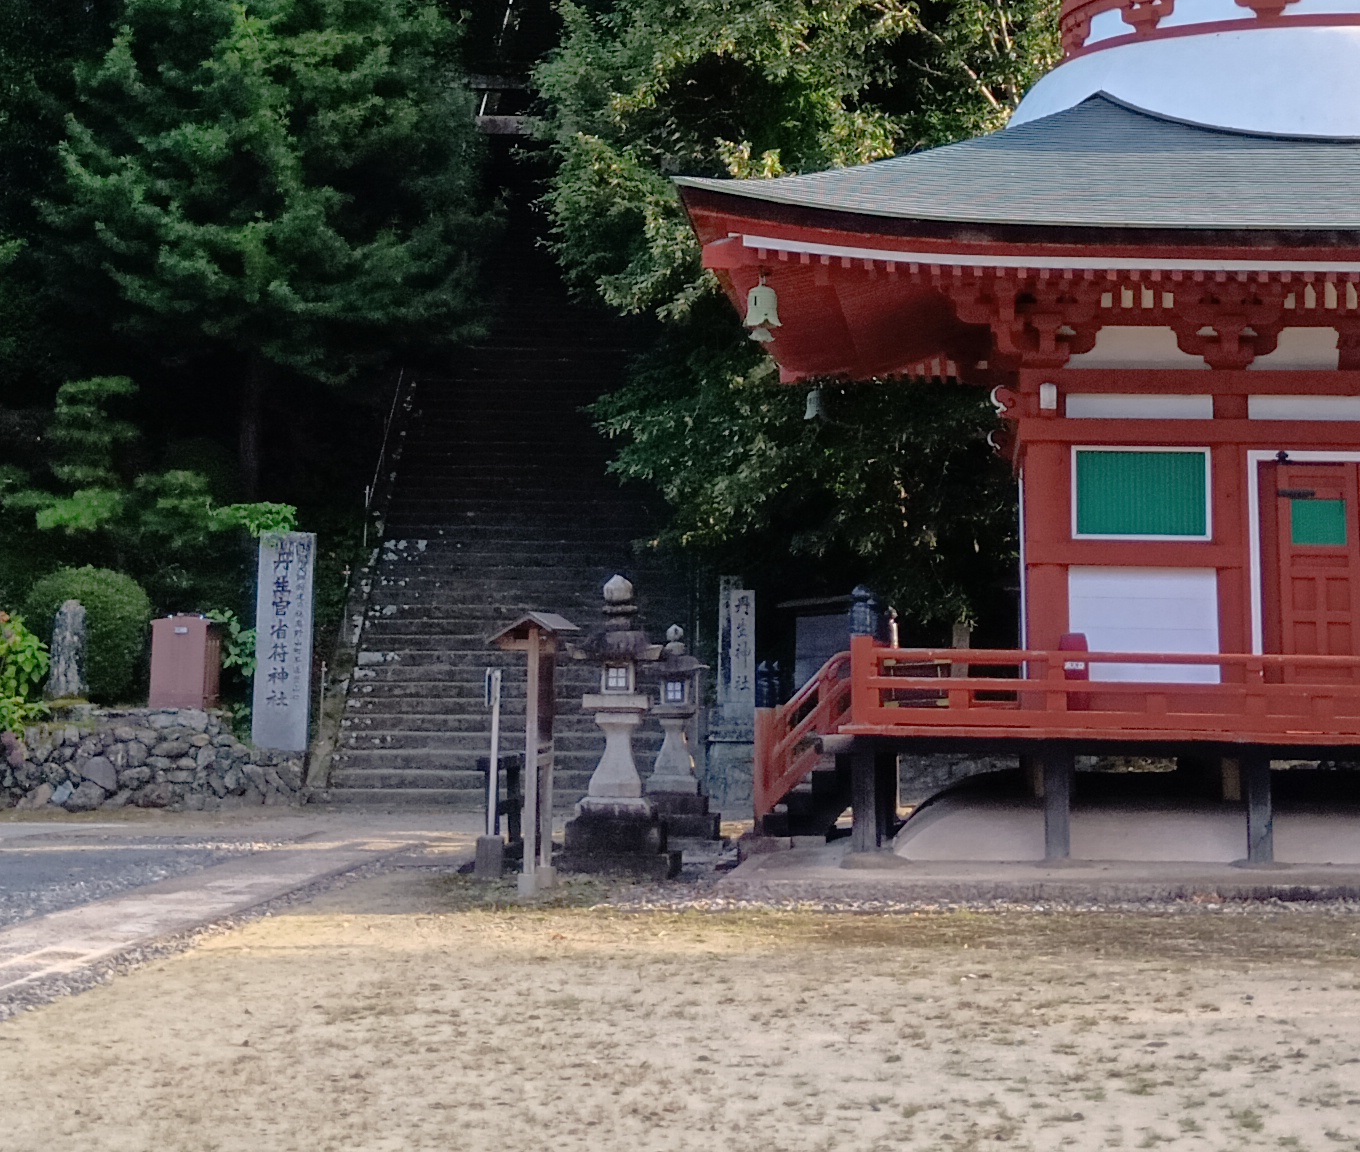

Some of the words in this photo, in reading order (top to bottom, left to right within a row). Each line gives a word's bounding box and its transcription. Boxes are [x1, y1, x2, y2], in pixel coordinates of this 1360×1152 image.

[266, 550, 293, 707] 丹生官省符神社
[735, 594, 752, 691] 丹生神社
